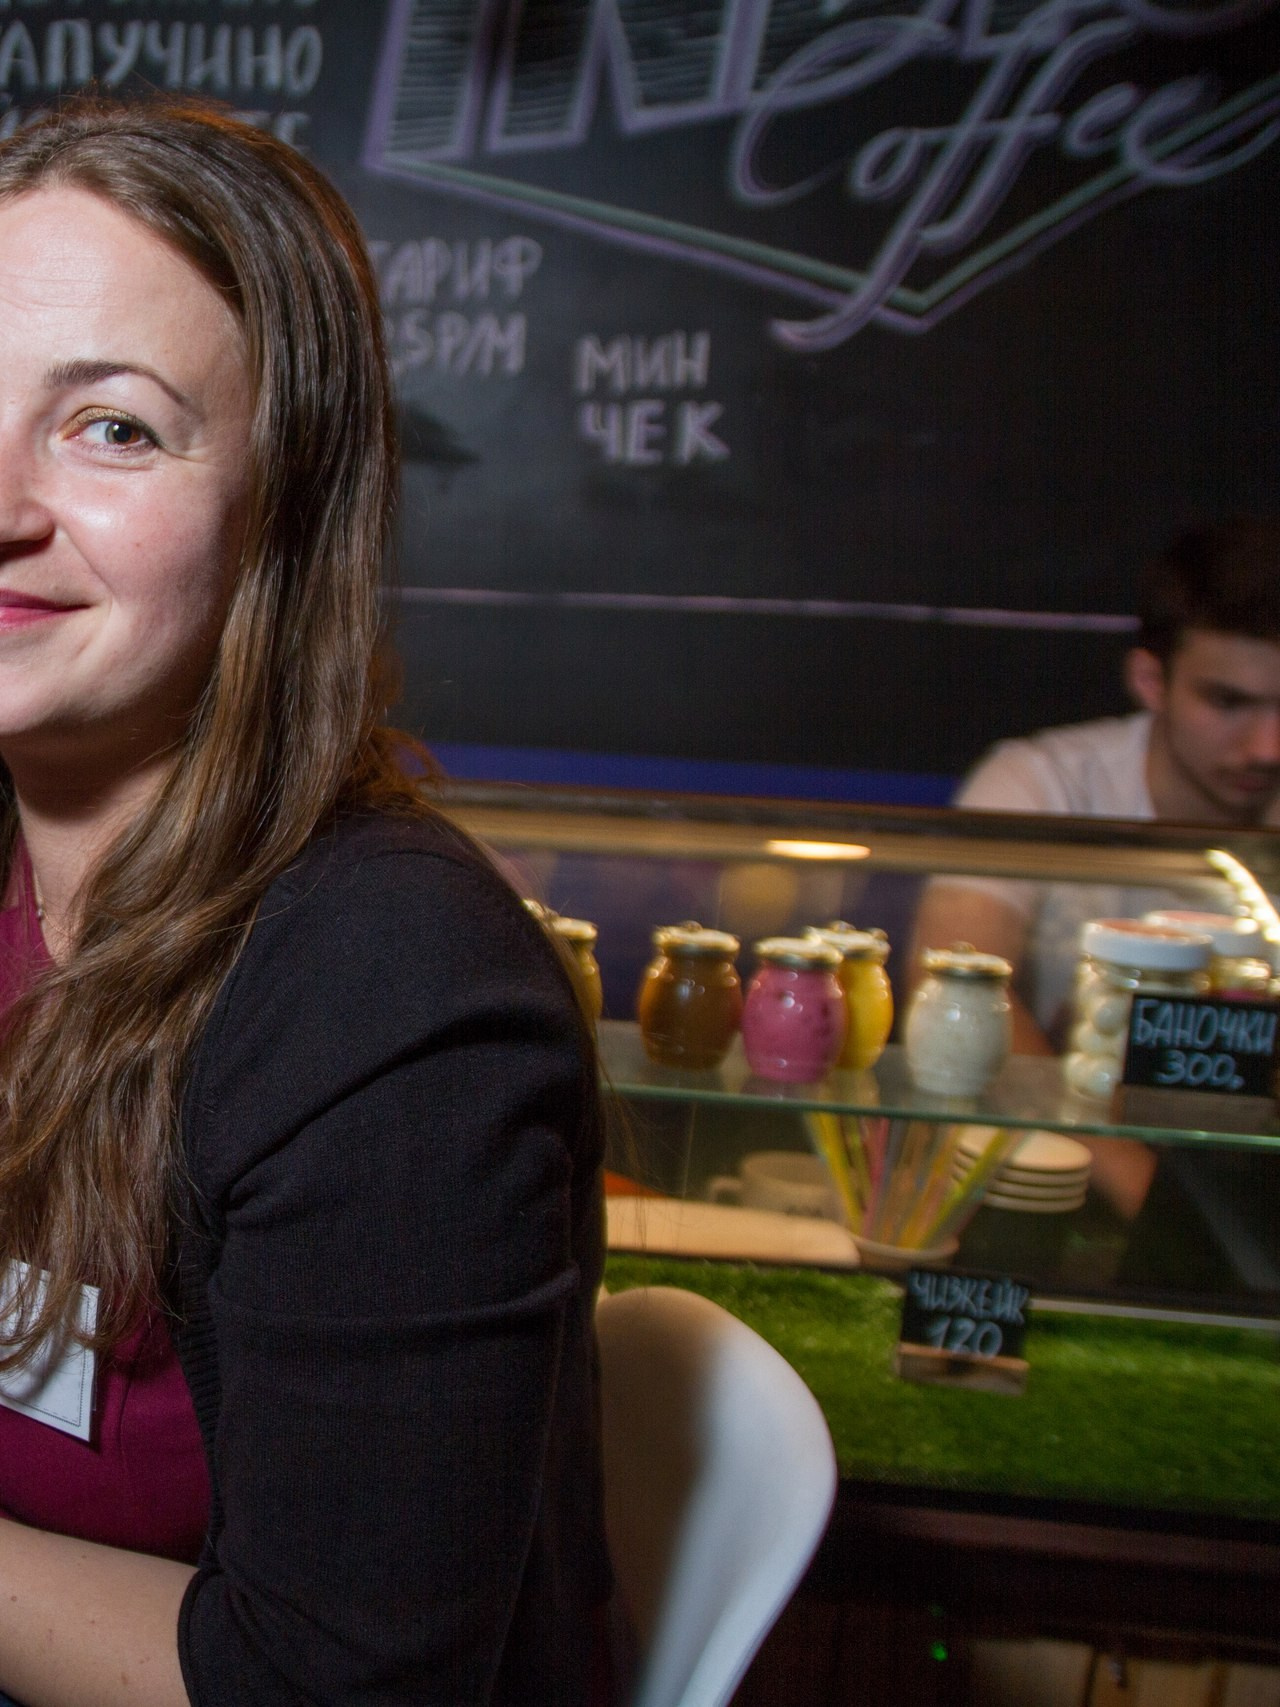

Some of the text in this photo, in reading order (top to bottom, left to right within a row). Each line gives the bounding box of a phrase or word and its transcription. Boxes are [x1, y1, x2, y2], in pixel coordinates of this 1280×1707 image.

[730, 12, 1280, 352] Coffee
[576, 330, 711, 392] МИН
[582, 400, 730, 464] ЧЕК
[1133, 998, 1277, 1056] БАНОЧКИ
[928, 1315, 1003, 1360] 120
